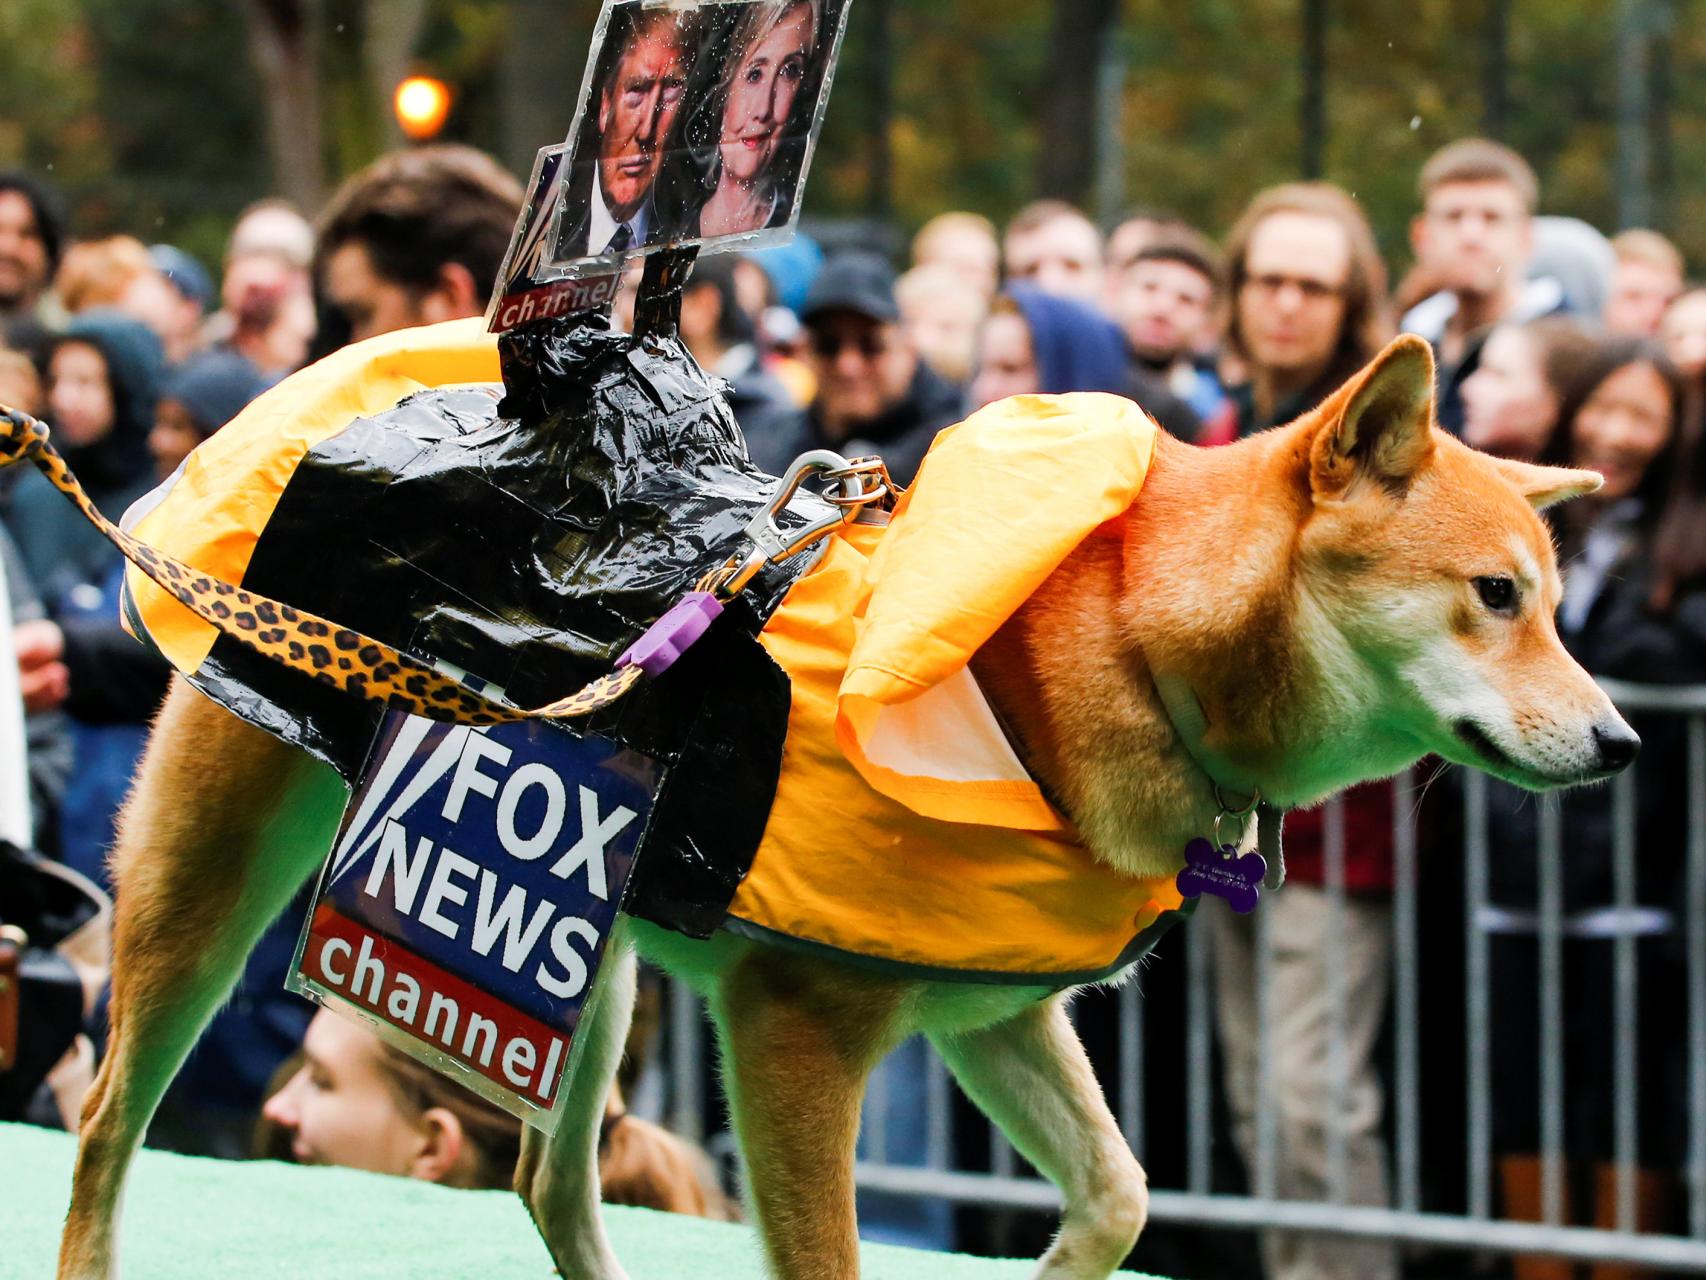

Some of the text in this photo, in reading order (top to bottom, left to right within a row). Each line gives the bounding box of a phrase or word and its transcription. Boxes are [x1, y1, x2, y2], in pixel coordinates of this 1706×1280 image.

[442, 728, 638, 901] FOX
[364, 819, 600, 999] NEWS
[320, 935, 563, 1099] channel
